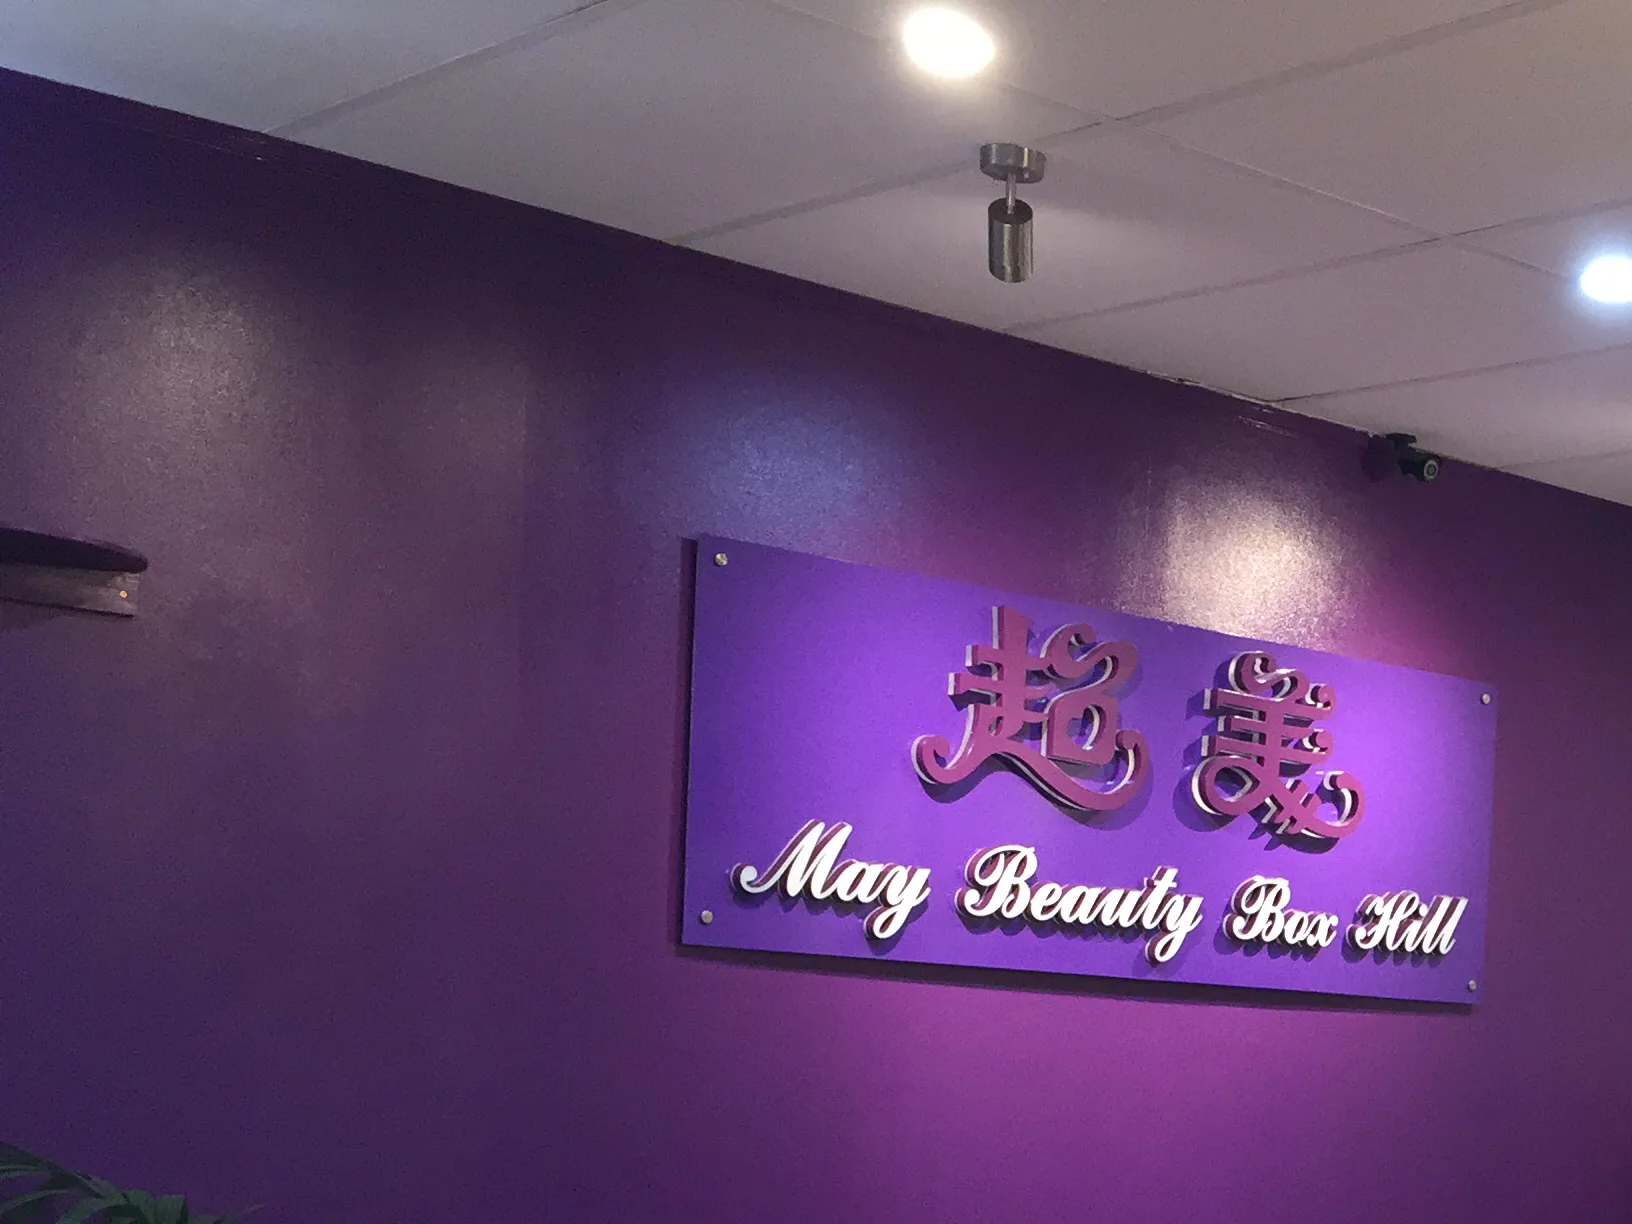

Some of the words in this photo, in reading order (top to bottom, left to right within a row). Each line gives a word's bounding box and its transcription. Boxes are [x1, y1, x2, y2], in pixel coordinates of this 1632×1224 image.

[730, 819, 931, 939] May
[955, 844, 1203, 963] Beauty
[1223, 875, 1338, 947] Box
[1346, 890, 1469, 954] Hill
